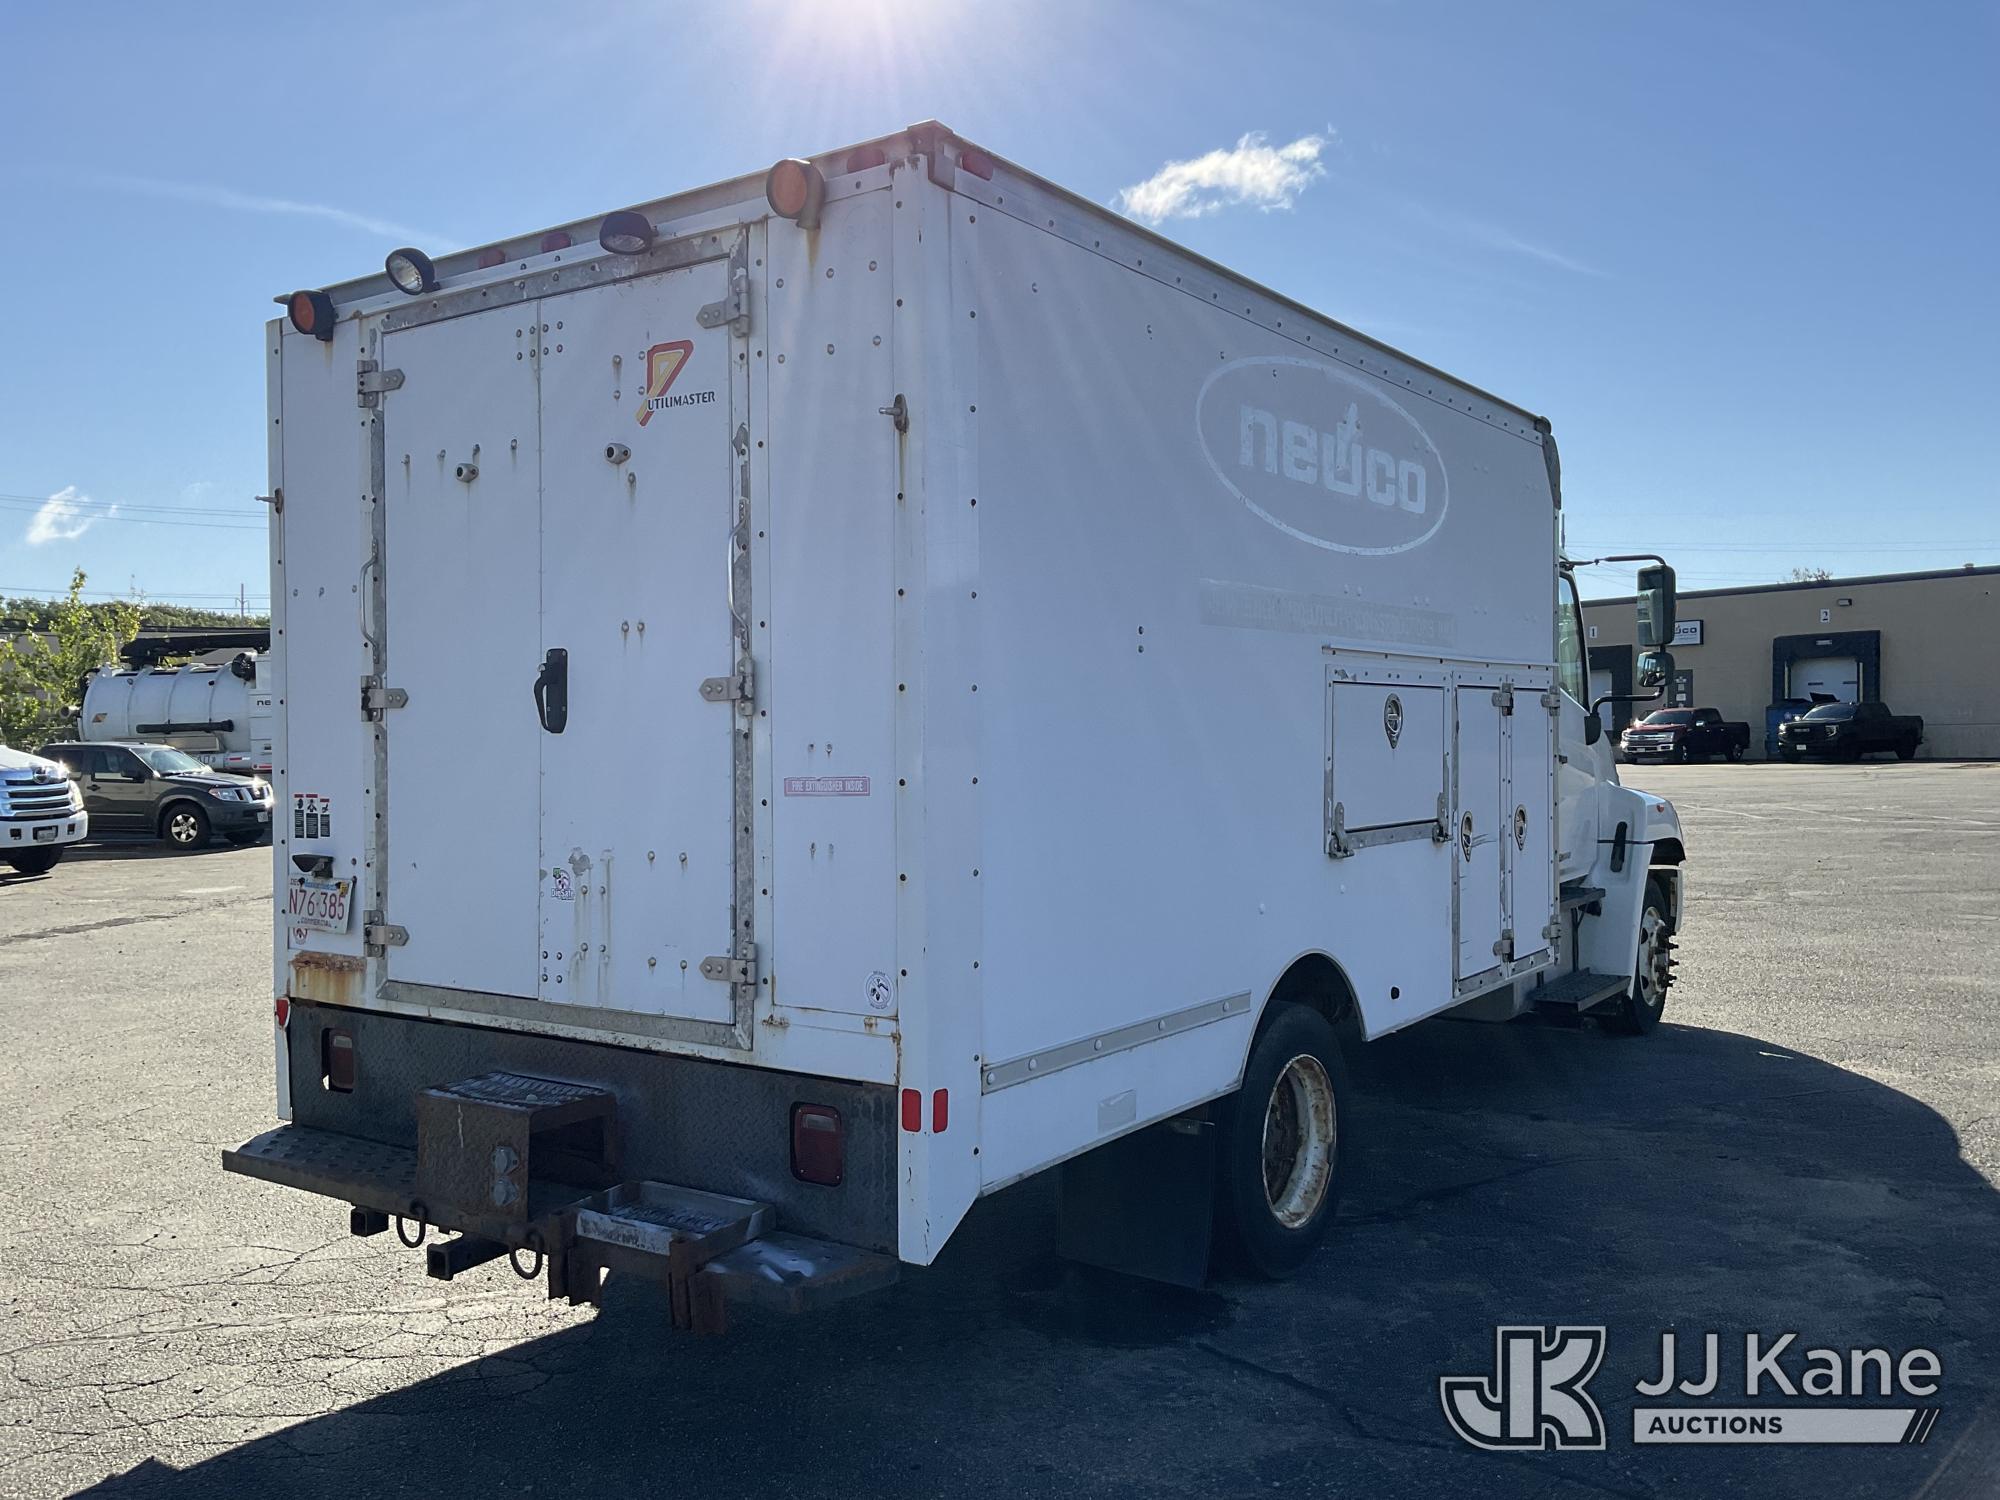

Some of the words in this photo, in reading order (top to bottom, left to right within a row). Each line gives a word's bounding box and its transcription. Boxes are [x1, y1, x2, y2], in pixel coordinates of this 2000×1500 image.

[648, 391, 715, 410] UTILIMASTER
[1822, 611, 1829, 621] 2
[791, 780, 804, 792] FIRE
[805, 781, 843, 792] EXTINGUISHER
[845, 780, 864, 792] INSIDE
